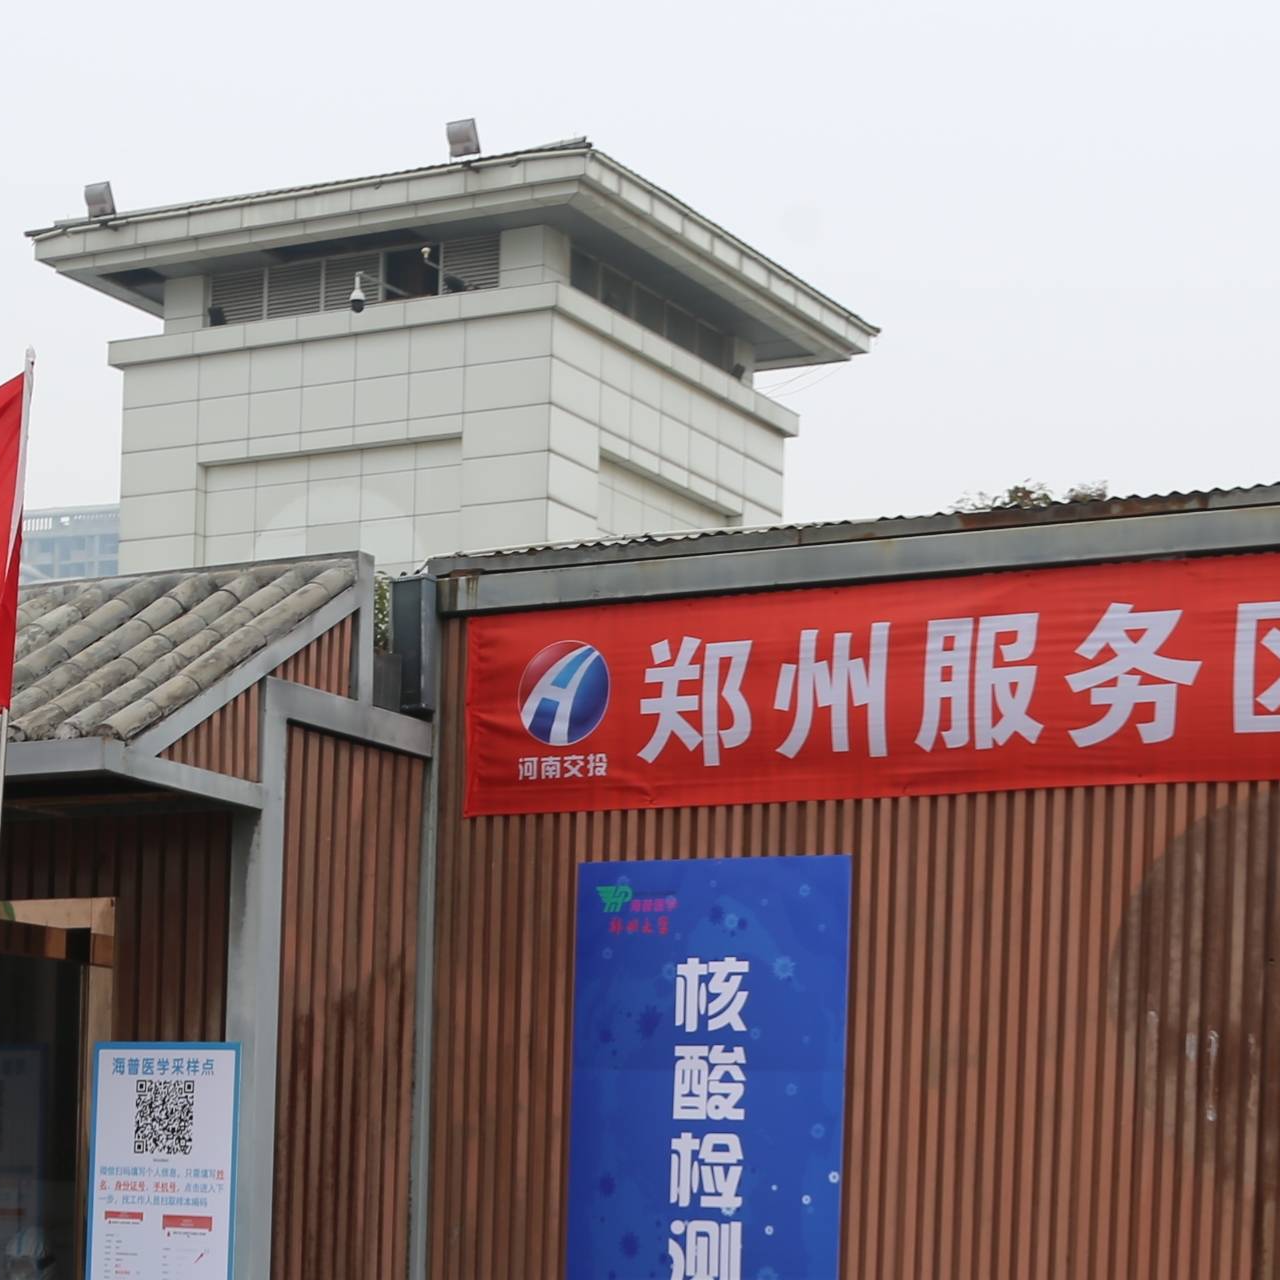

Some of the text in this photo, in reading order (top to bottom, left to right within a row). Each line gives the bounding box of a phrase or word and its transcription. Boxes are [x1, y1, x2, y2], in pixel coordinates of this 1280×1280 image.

[518, 752, 608, 781] 河南交投
[112, 1056, 216, 1077] 海普医学采样点
